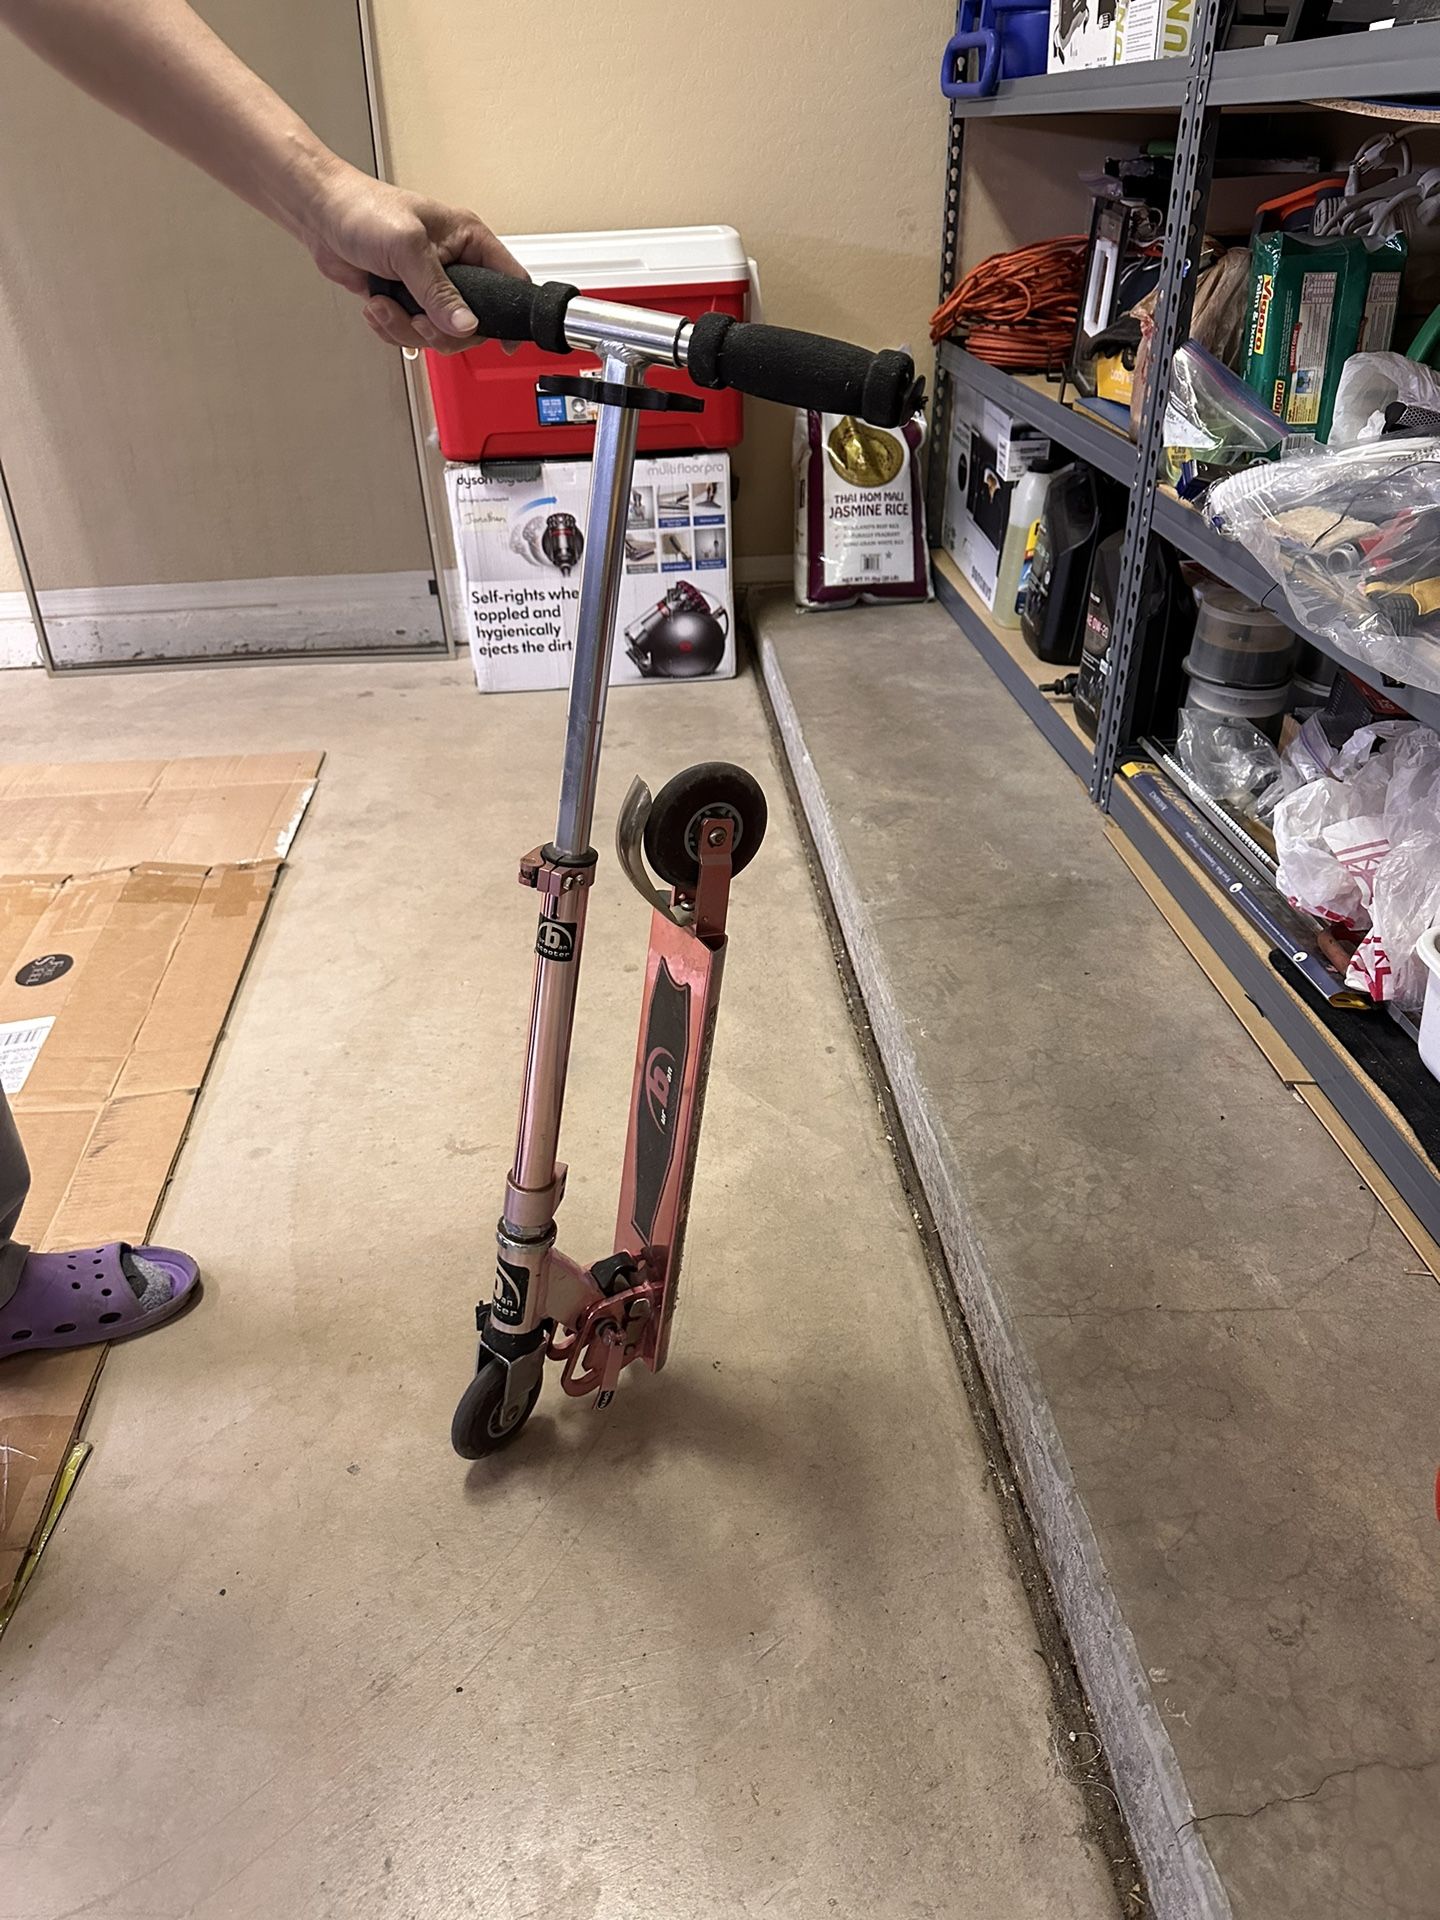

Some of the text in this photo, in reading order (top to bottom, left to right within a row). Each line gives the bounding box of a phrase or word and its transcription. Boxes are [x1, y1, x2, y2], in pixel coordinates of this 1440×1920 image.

[1164, 0, 1191, 52] UN
[1253, 275, 1264, 308] Palm
[1252, 311, 1259, 321] &
[1255, 279, 1273, 350] Vigoro
[1273, 382, 1284, 414] igoro
[457, 474, 493, 488] dyson
[834, 491, 904, 504] THAI HOM MALI
[829, 503, 909, 519] JASMINE RICE
[471, 586, 580, 606] Self-rights whe
[474, 604, 561, 624] toppled and
[476, 622, 561, 641] hygienically
[479, 638, 572, 658] ejects the dirt
